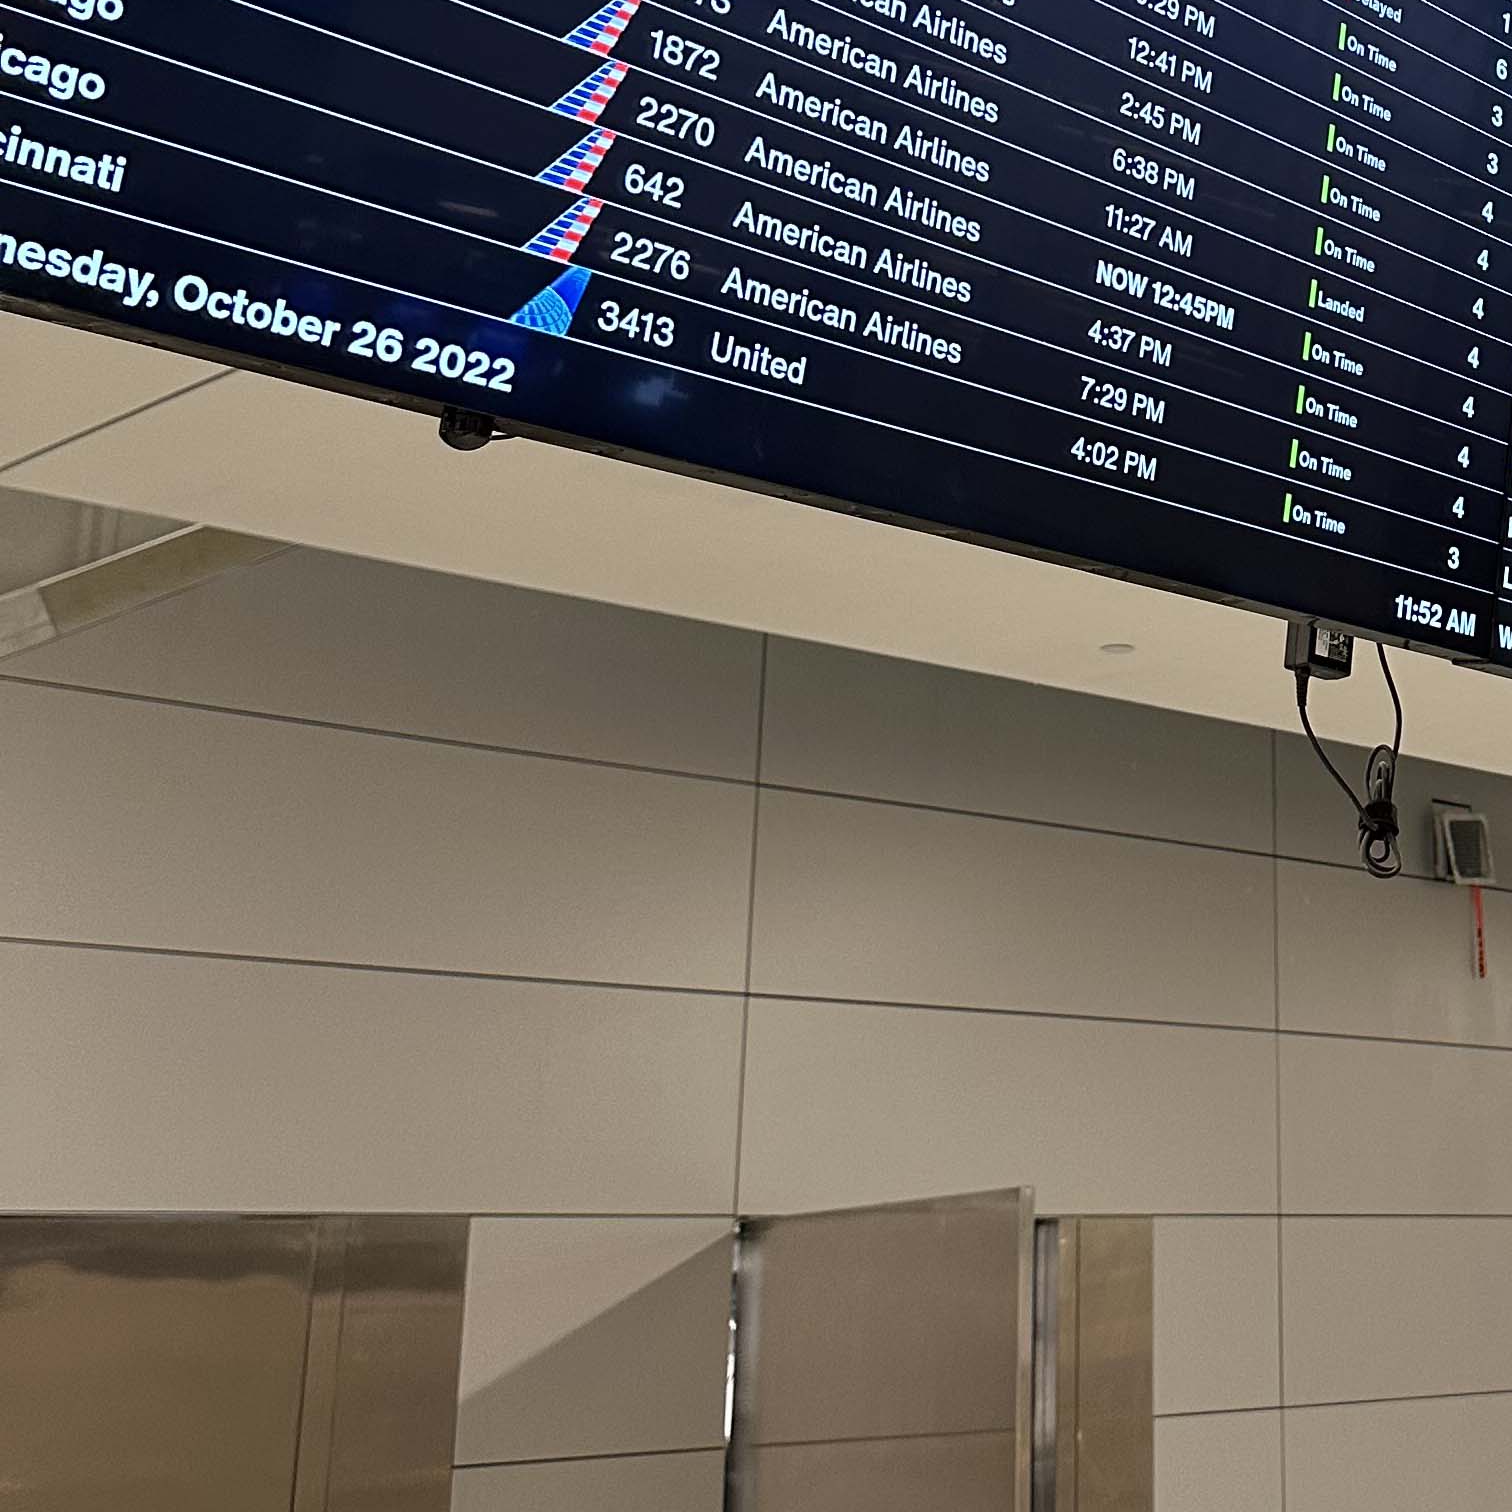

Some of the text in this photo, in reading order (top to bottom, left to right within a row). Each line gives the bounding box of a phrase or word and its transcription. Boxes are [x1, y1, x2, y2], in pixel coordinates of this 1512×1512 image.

[911, 3, 1007, 65] Airlines
[1183, 4, 1216, 39] PM
[649, 29, 721, 82] 1872
[766, 8, 999, 124] American Airlines
[1127, 36, 1213, 94] 12:41 PM
[635, 95, 715, 148] 2270
[754, 71, 990, 183] American Airlines
[1119, 91, 1201, 146] 2:45 PM
[623, 163, 685, 209] 642
[743, 136, 981, 243] American Airlines
[1112, 147, 1195, 201] 6:38 PM
[609, 231, 691, 281] 2276
[732, 201, 972, 303] American Airlines
[1105, 203, 1193, 258] 11:27 AM
[720, 266, 962, 364] American Airlines
[1095, 259, 1235, 331] NOW 12:45PM
[1317, 289, 1365, 323] Landed
[173, 274, 342, 348] October
[346, 320, 405, 364] 26
[410, 337, 516, 394] 2022
[596, 299, 675, 348] 3413
[1087, 319, 1172, 368] 4:37 PM
[710, 331, 808, 386] United
[1080, 375, 1166, 425] 7:29 PM
[1069, 436, 1157, 482] 4:02 PM
[1394, 593, 1476, 638] 11:52 AM
